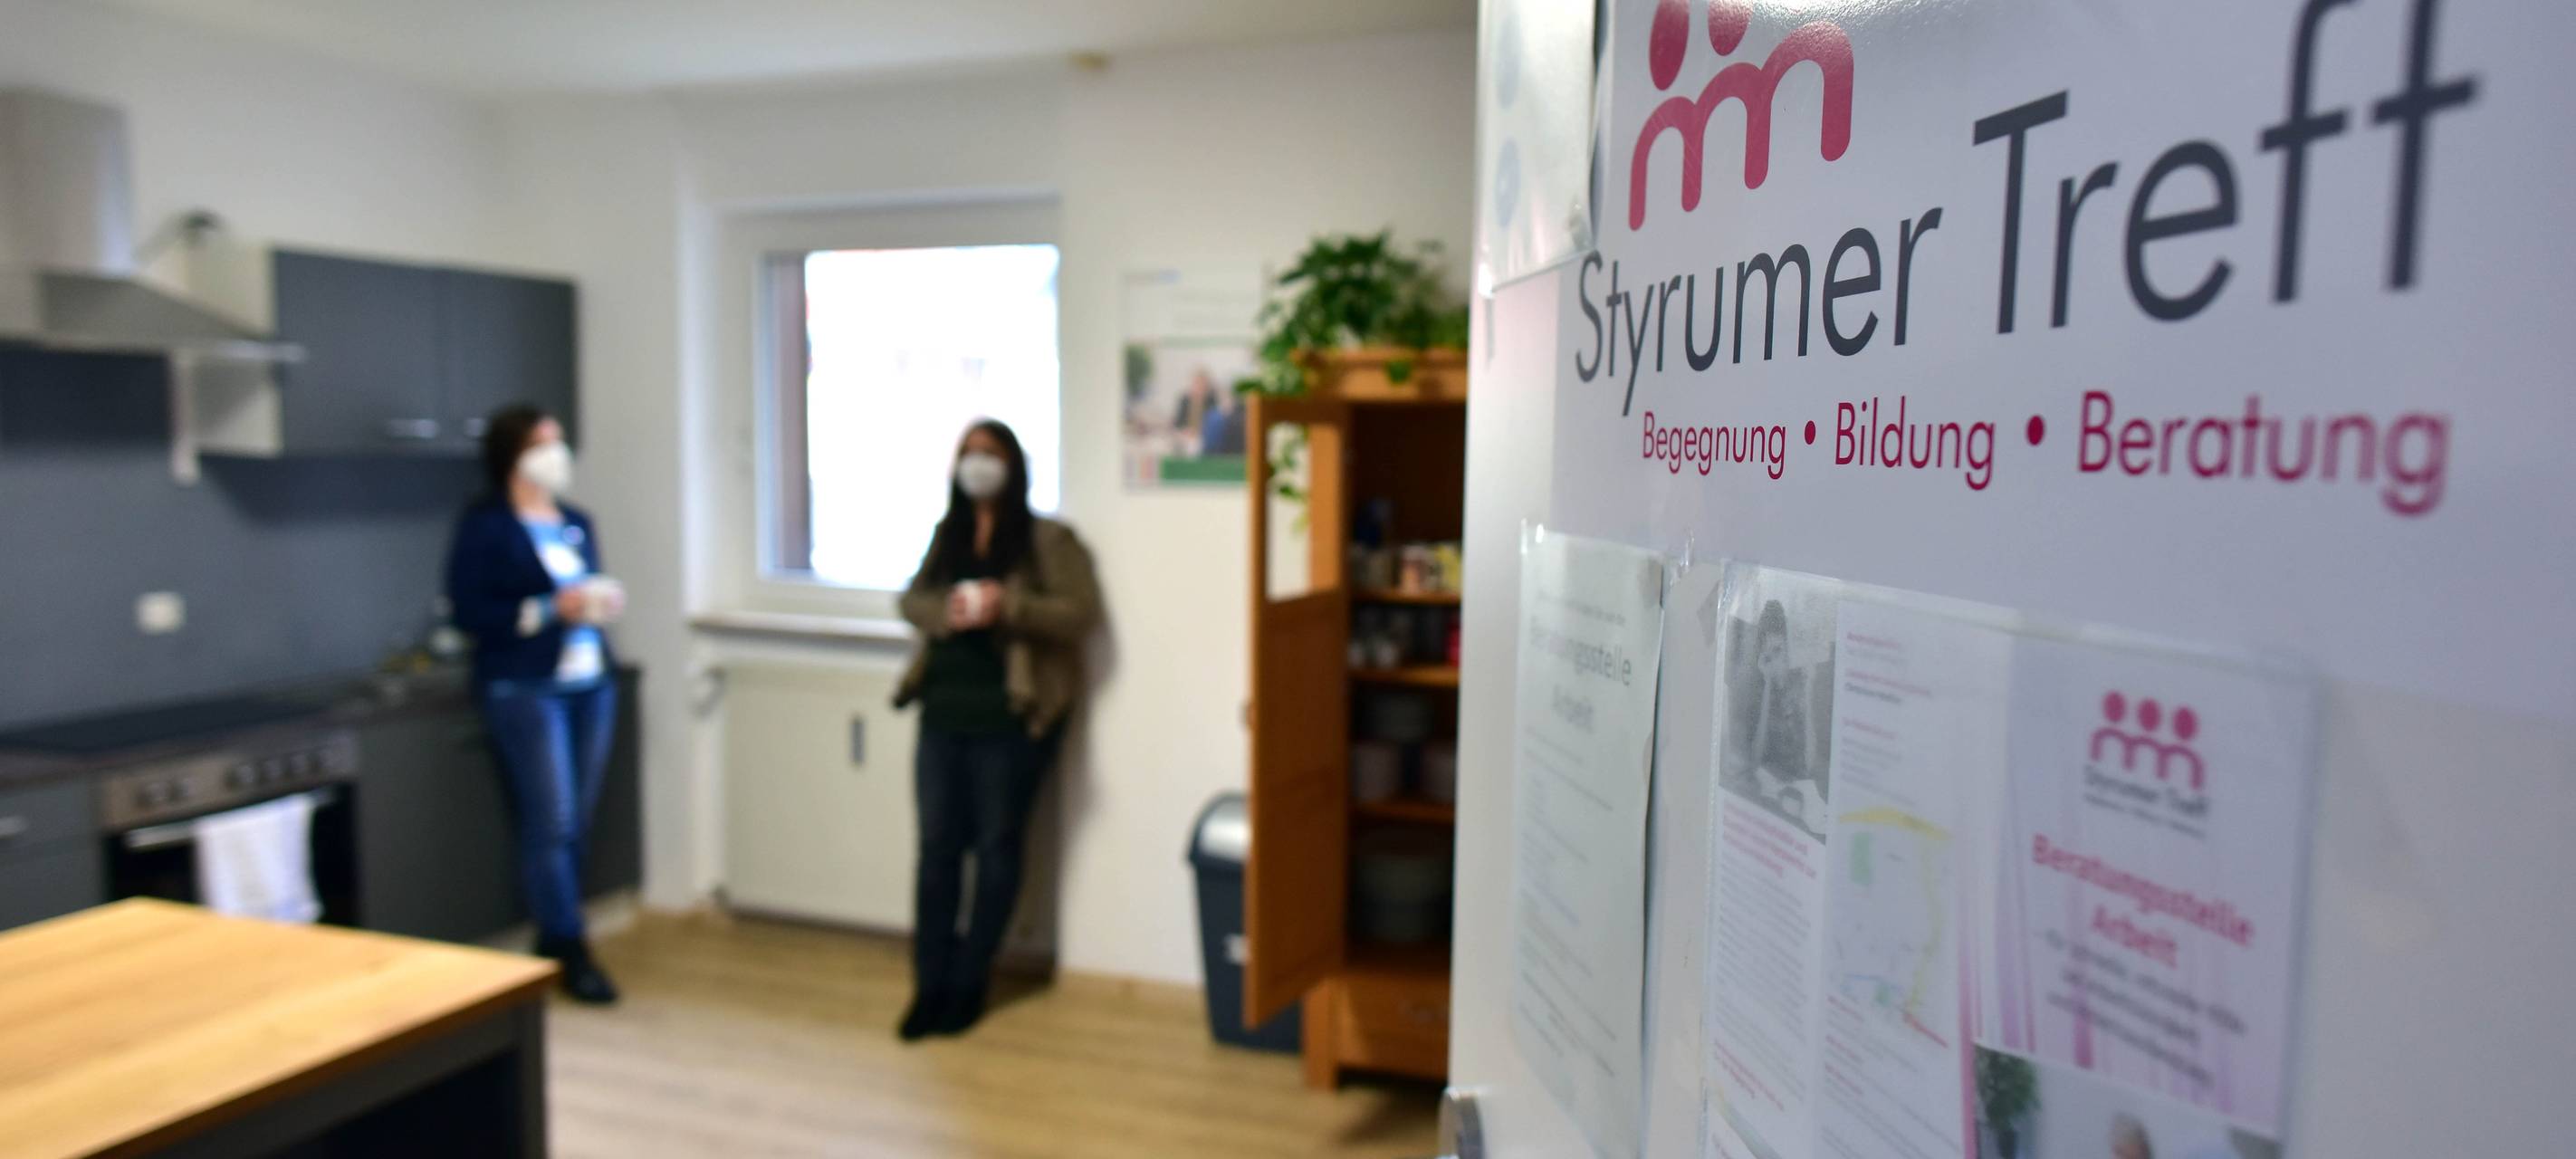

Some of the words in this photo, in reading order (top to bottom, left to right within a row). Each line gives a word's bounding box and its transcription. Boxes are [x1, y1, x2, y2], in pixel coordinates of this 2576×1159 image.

[1575, 206, 1944, 418] Styrumer
[1972, 0, 2482, 335] Treff
[1642, 410, 1787, 481] Begegnung
[1834, 396, 1995, 492] Bildung
[2078, 389, 2452, 517] Beratung
